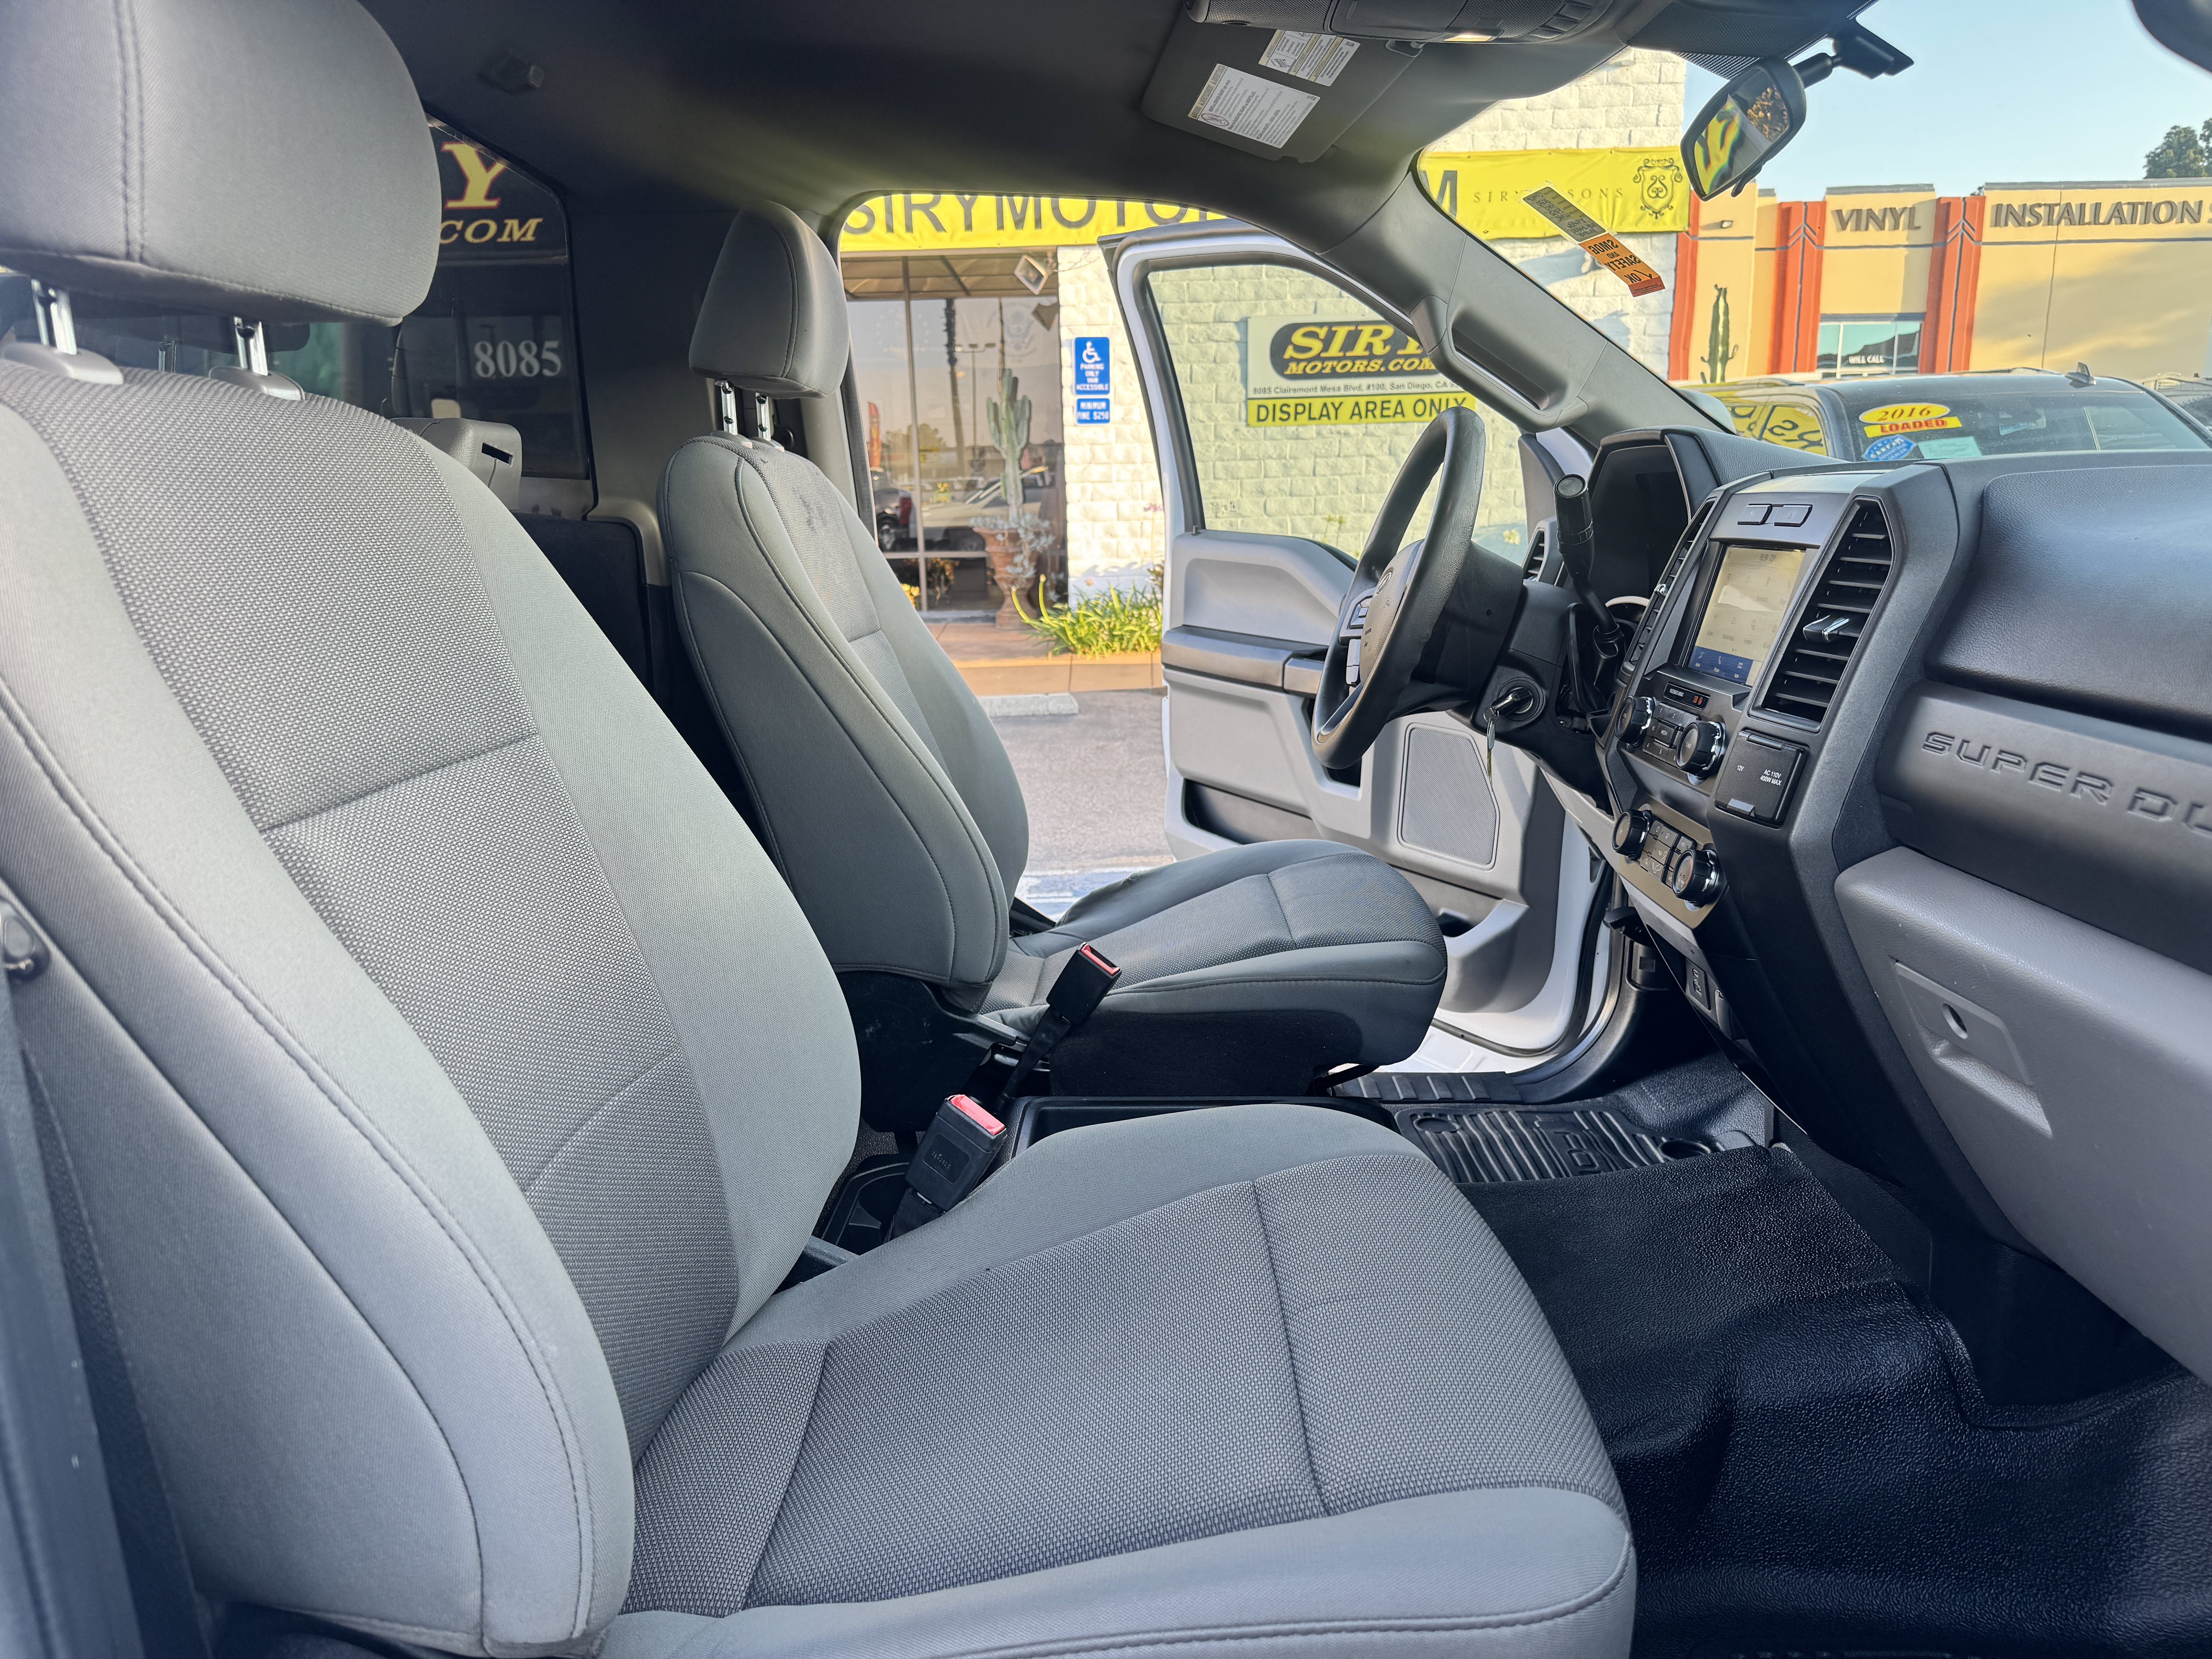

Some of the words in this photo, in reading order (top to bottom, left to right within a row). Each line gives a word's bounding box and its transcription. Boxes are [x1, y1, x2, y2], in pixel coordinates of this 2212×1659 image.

[1473, 191, 1518, 203] SIR
[1568, 188, 1623, 199] SONS
[1833, 206, 1921, 231] VINYL
[1994, 200, 2203, 227] INSTALLATION
[474, 340, 562, 378] 8085
[1284, 357, 1436, 374] MOTORS.COM
[1256, 401, 1343, 422] DISPLAY
[1350, 399, 1405, 420] AREA
[1877, 406, 1931, 421] 2016
[1880, 419, 1948, 434] LOADED
[1771, 771, 1781, 779] 110V
[1921, 731, 2113, 805] SUPER
[1760, 775, 1772, 783] 400W
[1771, 778, 1782, 786] MAX
